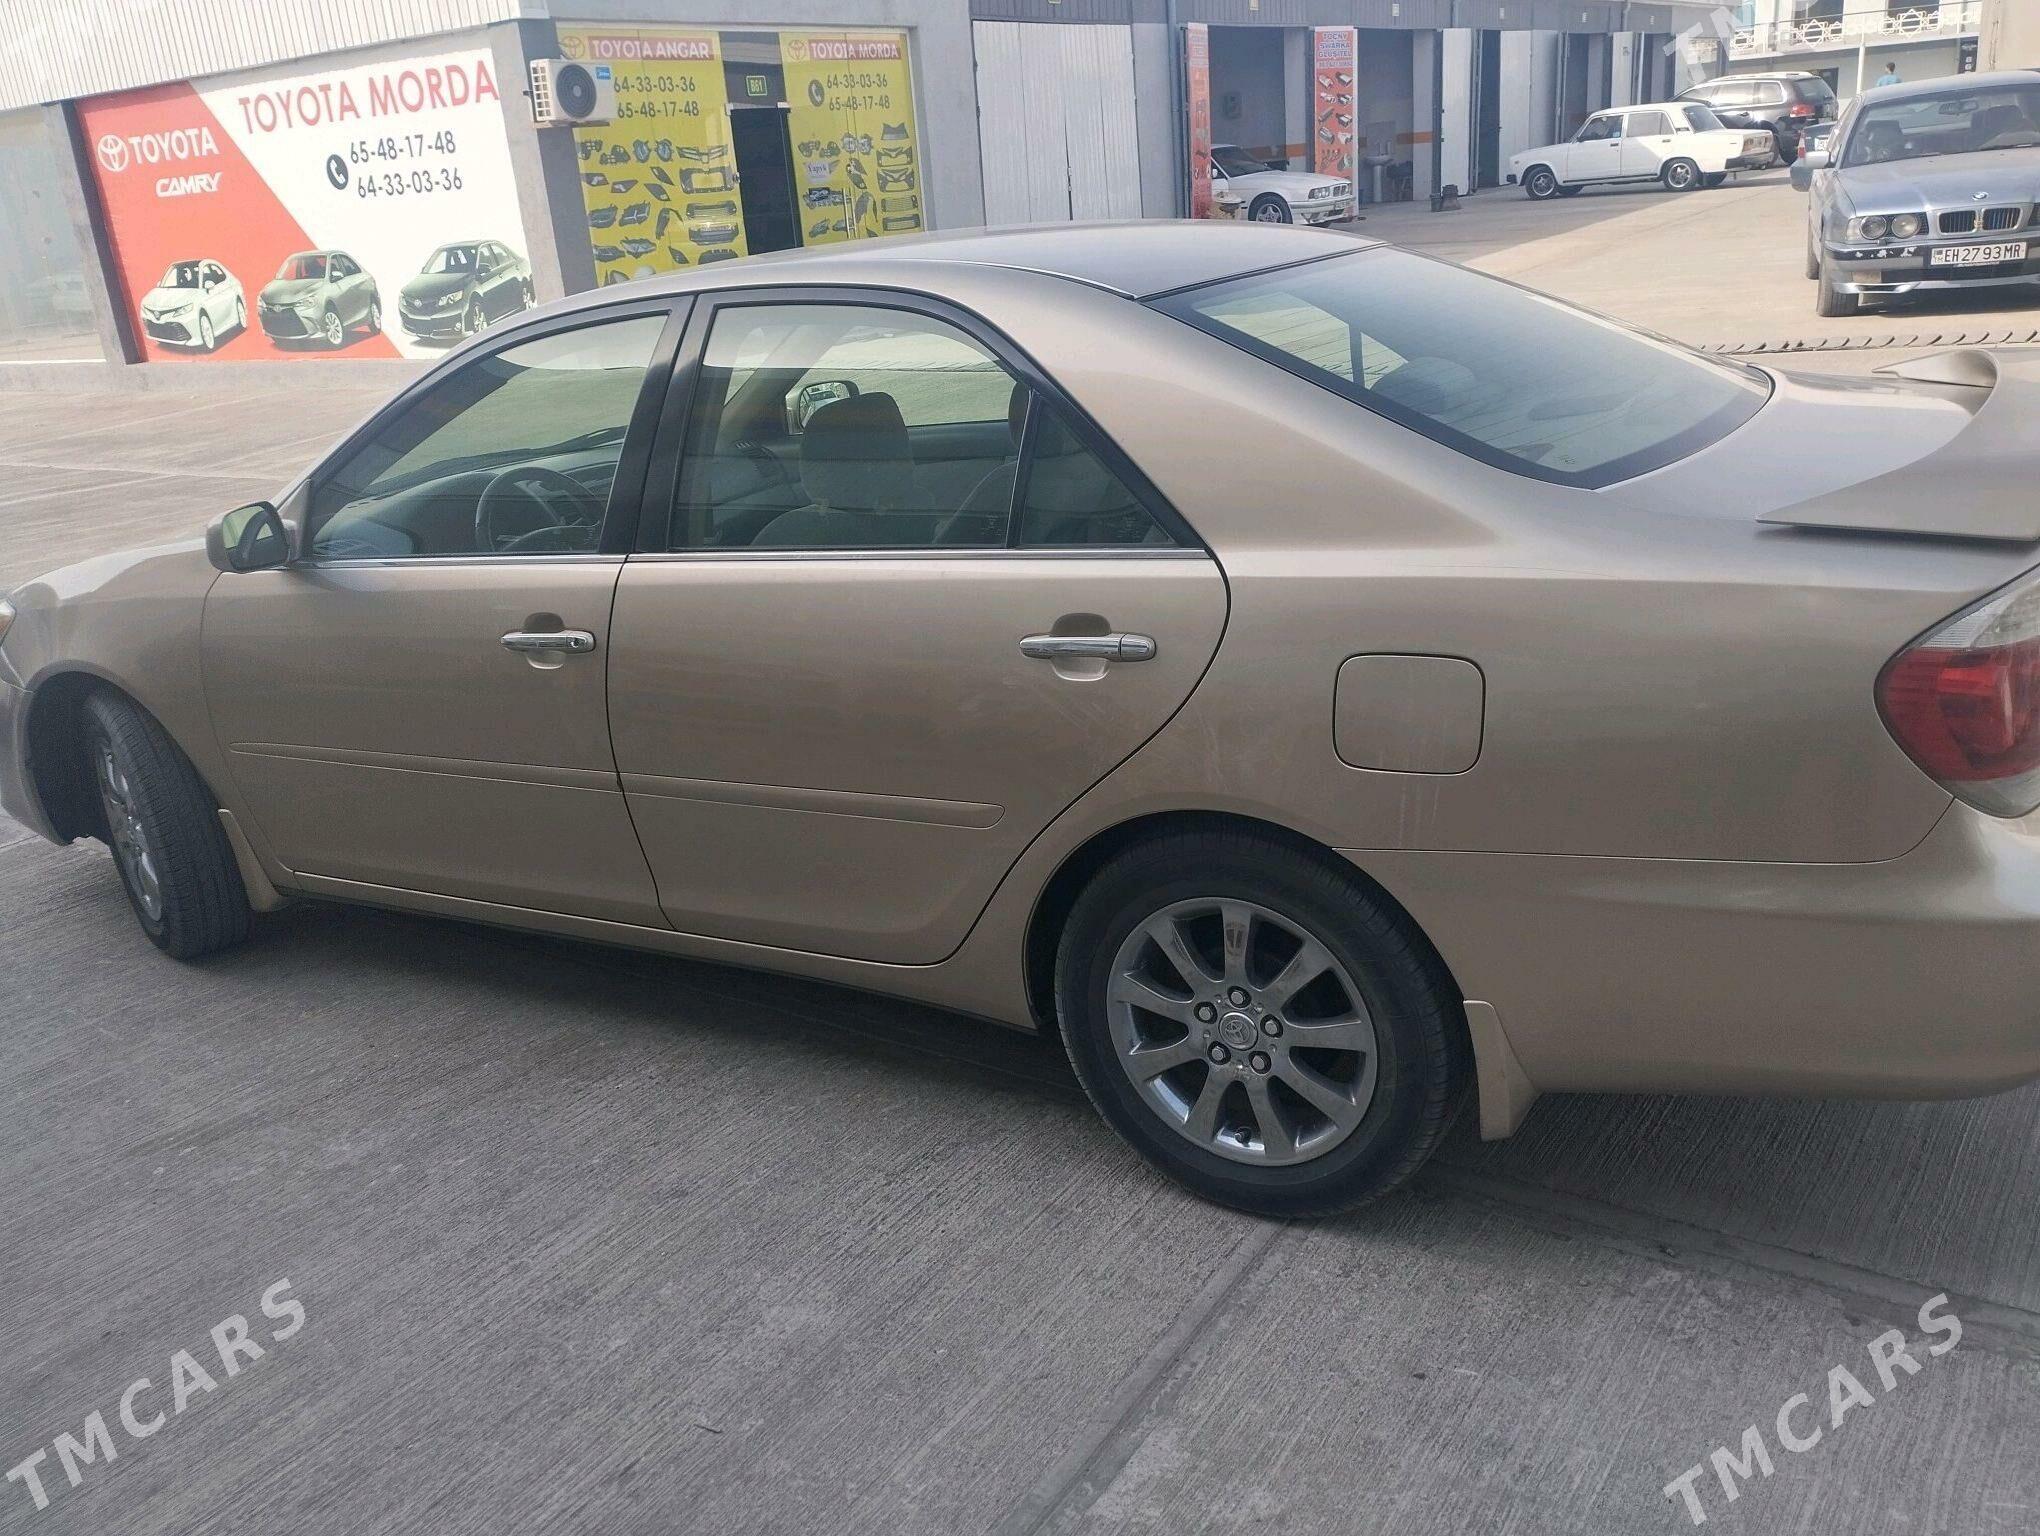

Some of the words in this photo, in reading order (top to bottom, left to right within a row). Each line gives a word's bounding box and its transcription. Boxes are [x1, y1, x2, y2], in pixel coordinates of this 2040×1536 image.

[593, 39, 653, 58] TOYOTA
[655, 41, 710, 59] ANGAR
[812, 43, 856, 59] TOYOTA
[859, 43, 899, 58] MORDA
[614, 76, 695, 93] 64-33-03-36
[826, 74, 888, 89] 64-33-03-36
[238, 81, 361, 134] TOYOTA
[368, 60, 500, 117] MORDA
[829, 95, 890, 111] 65-48-17-48
[617, 101, 699, 118] 65-48-17-48
[128, 126, 220, 164] TOYOTA
[351, 130, 456, 164] 65-48-17-48
[156, 172, 222, 197] CAMRY
[357, 167, 463, 198] 64-33-03-36
